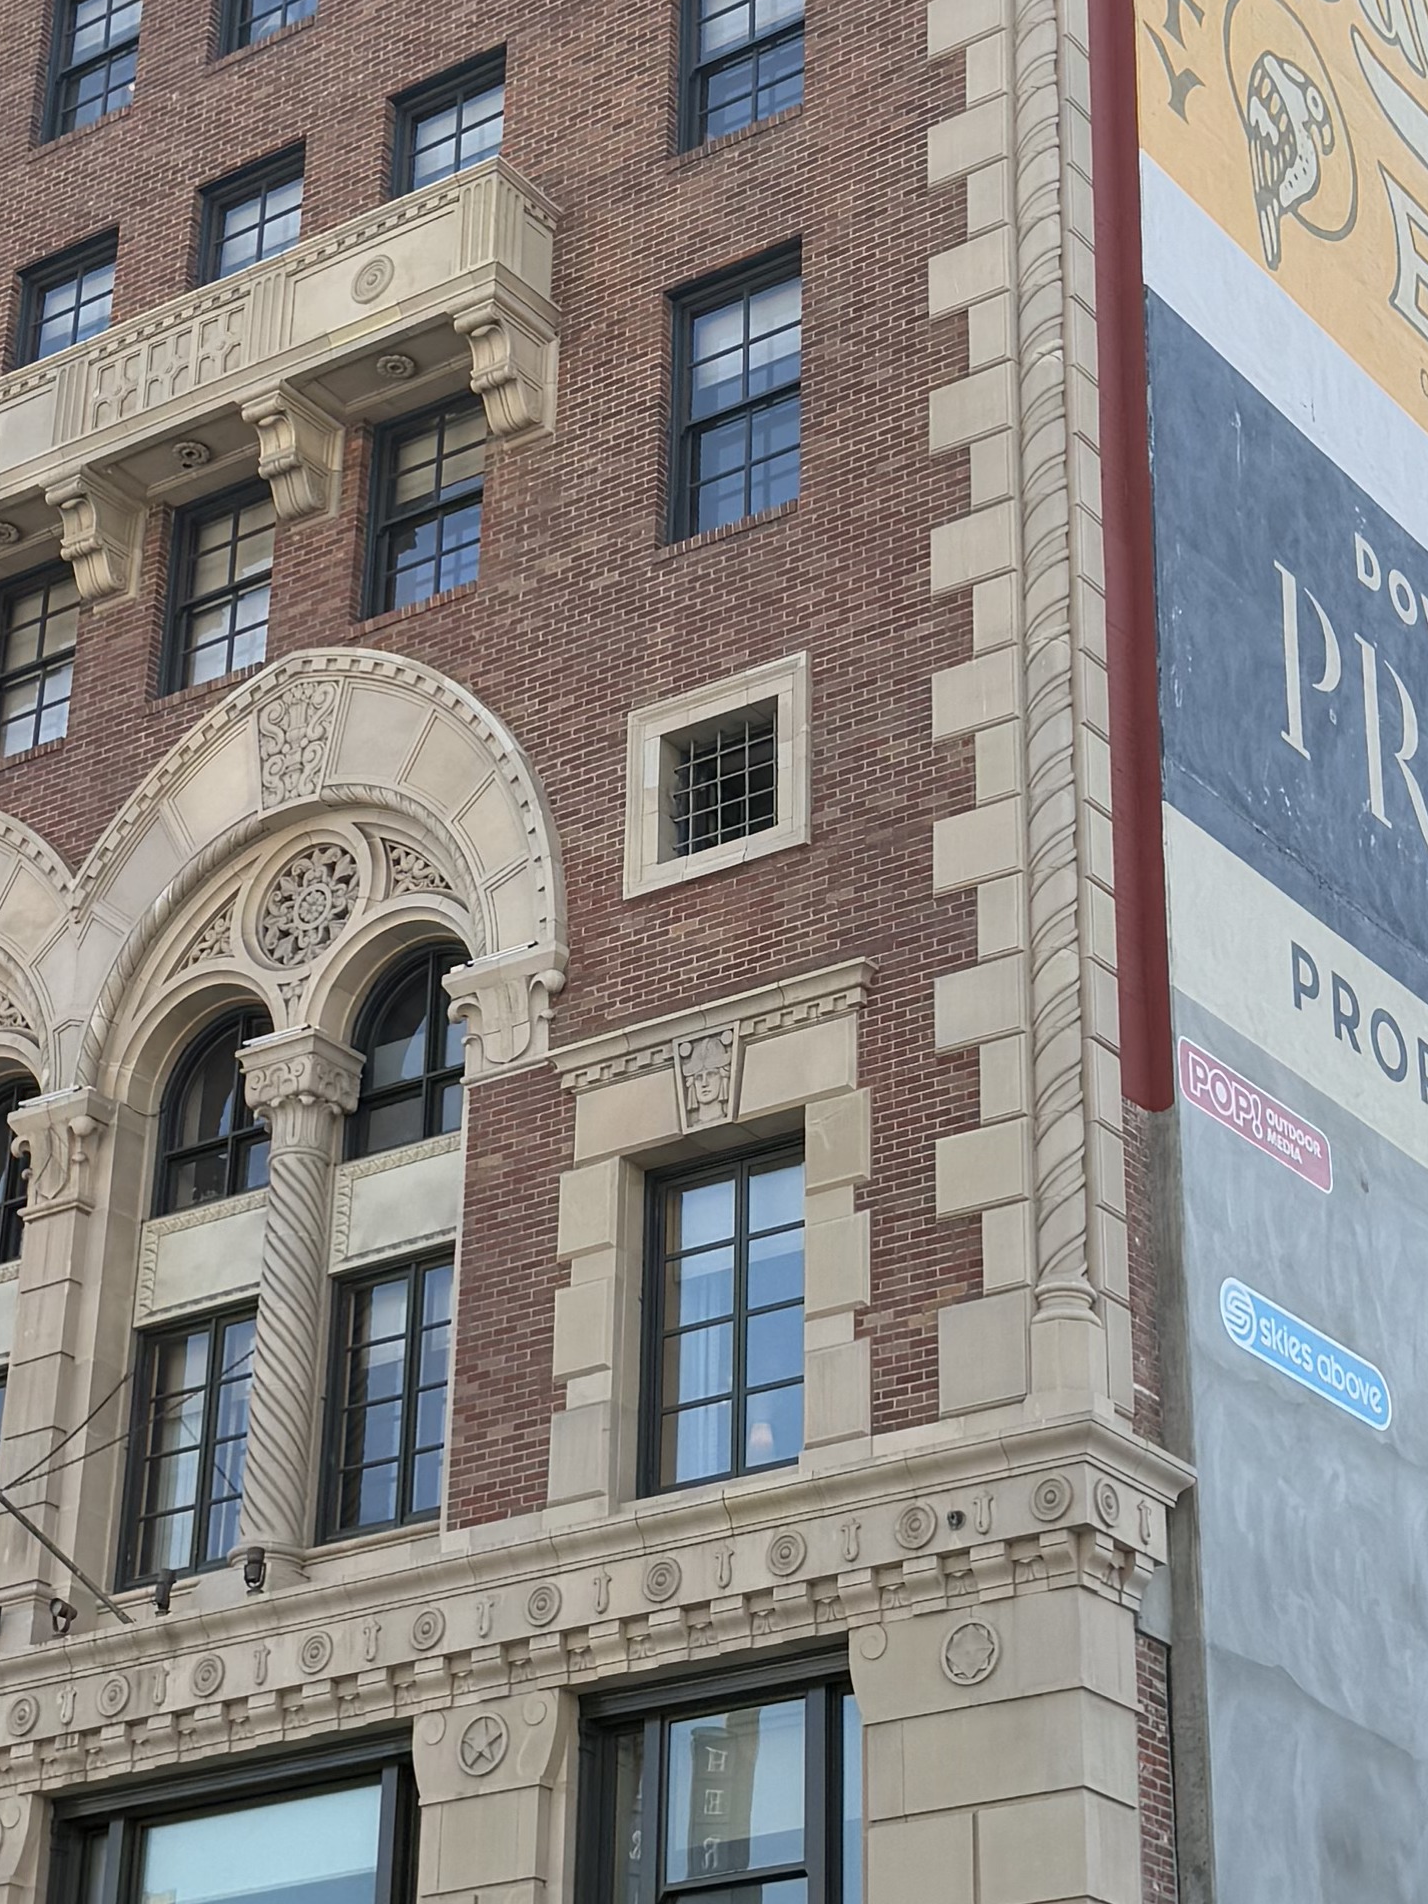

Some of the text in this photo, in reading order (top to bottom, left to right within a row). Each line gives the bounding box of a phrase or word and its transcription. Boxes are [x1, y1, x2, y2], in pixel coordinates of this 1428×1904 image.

[1188, 1050, 1263, 1140] POP!
[1265, 1107, 1323, 1159] OUTDOOR
[1266, 1128, 1303, 1165] MEDIA
[1260, 1316, 1383, 1415] skies above
